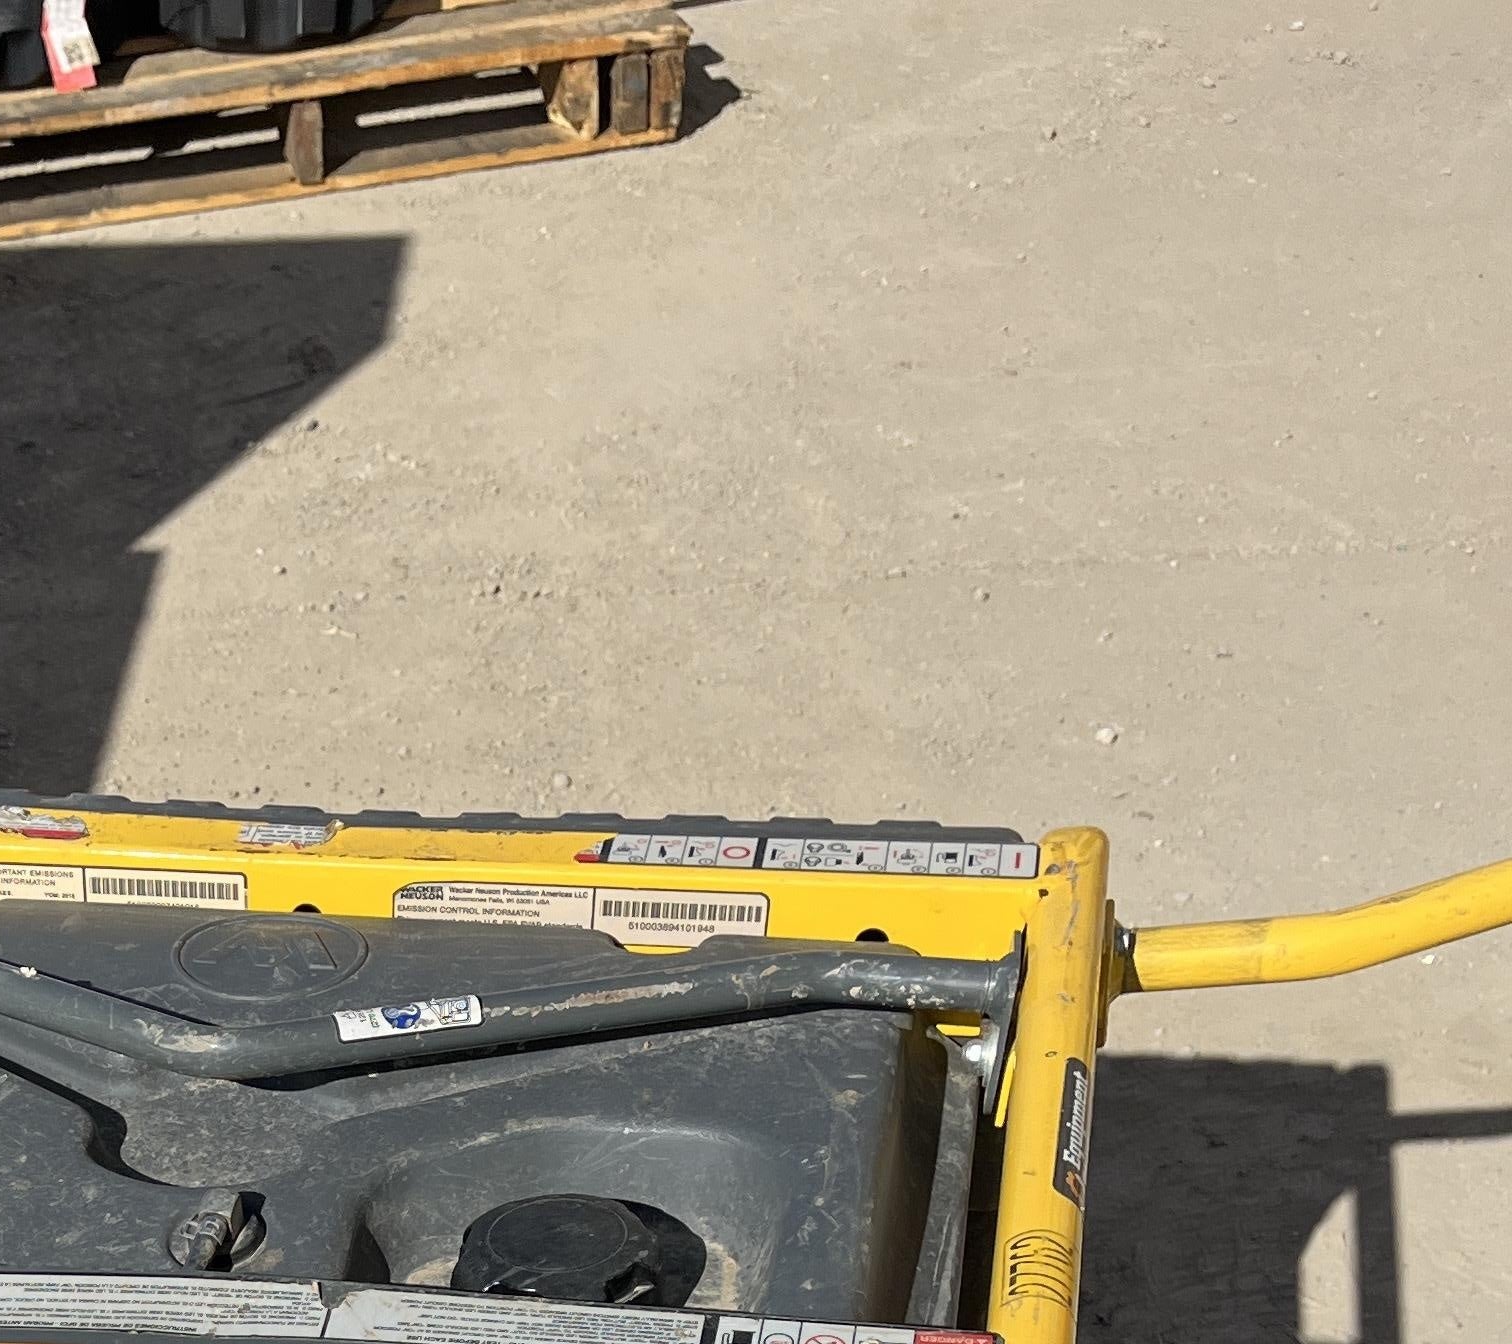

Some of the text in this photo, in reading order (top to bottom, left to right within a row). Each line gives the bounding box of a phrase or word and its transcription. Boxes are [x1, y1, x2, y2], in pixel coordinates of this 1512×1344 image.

[30, 870, 74, 878] EMISSIONS
[1, 878, 55, 886] INFORMATION
[398, 905, 539, 917] EMISSION CONTROL INFORMATION
[919, 1334, 974, 1344] DANGER
